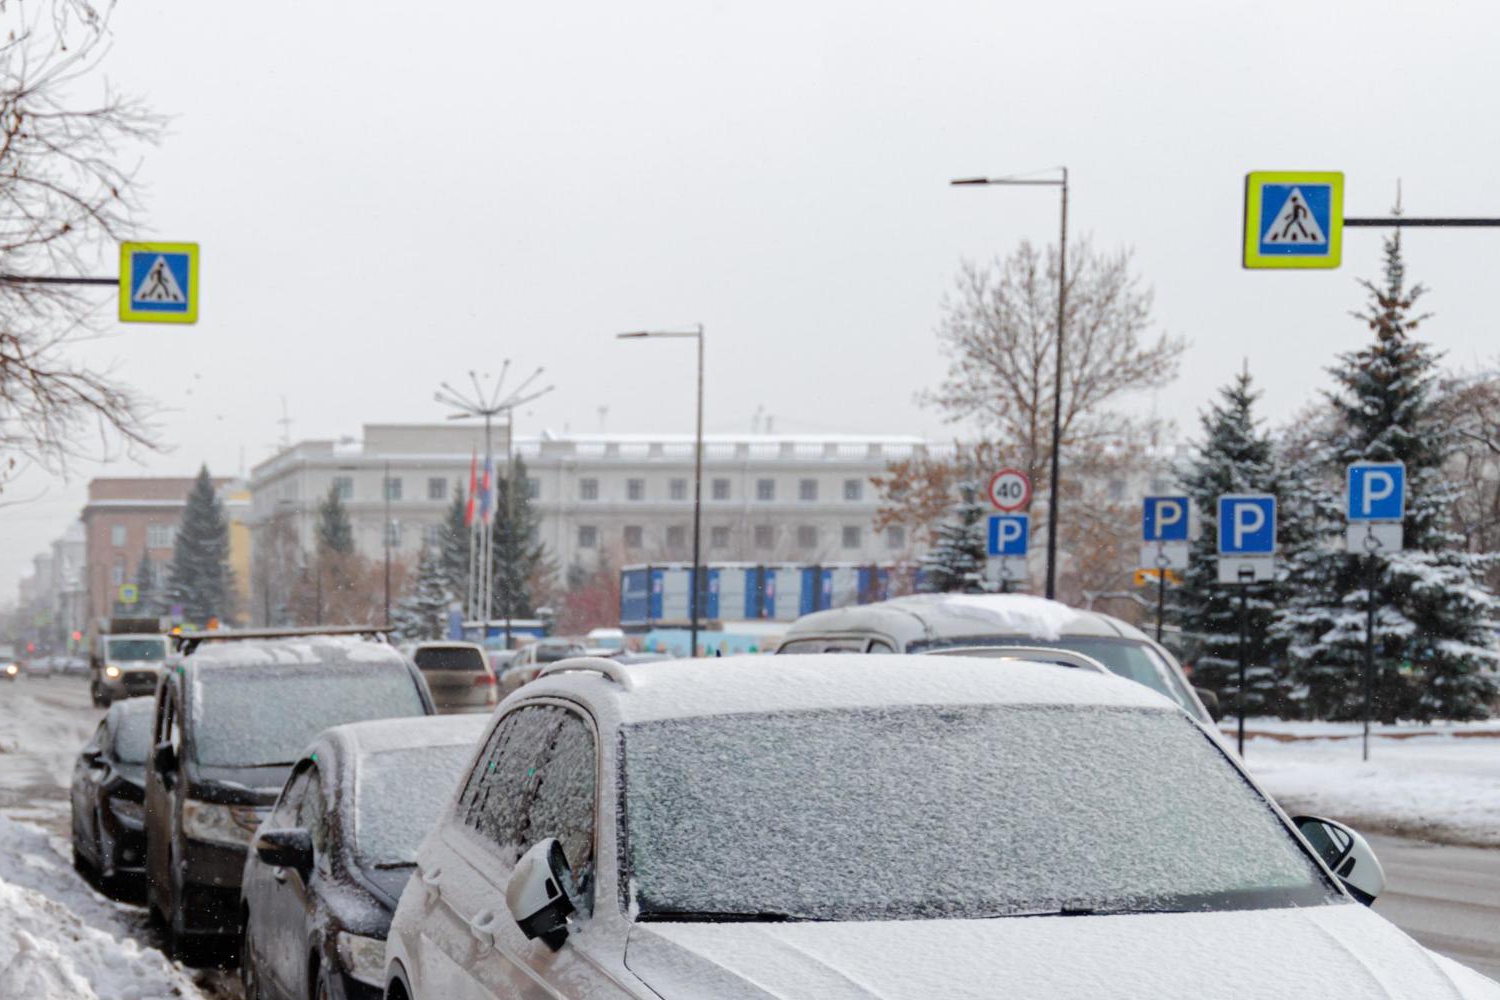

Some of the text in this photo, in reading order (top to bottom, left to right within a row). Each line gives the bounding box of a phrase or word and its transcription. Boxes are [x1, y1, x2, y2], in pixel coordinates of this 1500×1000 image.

[996, 482, 1022, 498] 40
[1362, 471, 1394, 515] P
[997, 519, 1022, 552] P
[1155, 501, 1182, 538] P
[1233, 503, 1265, 549] P
